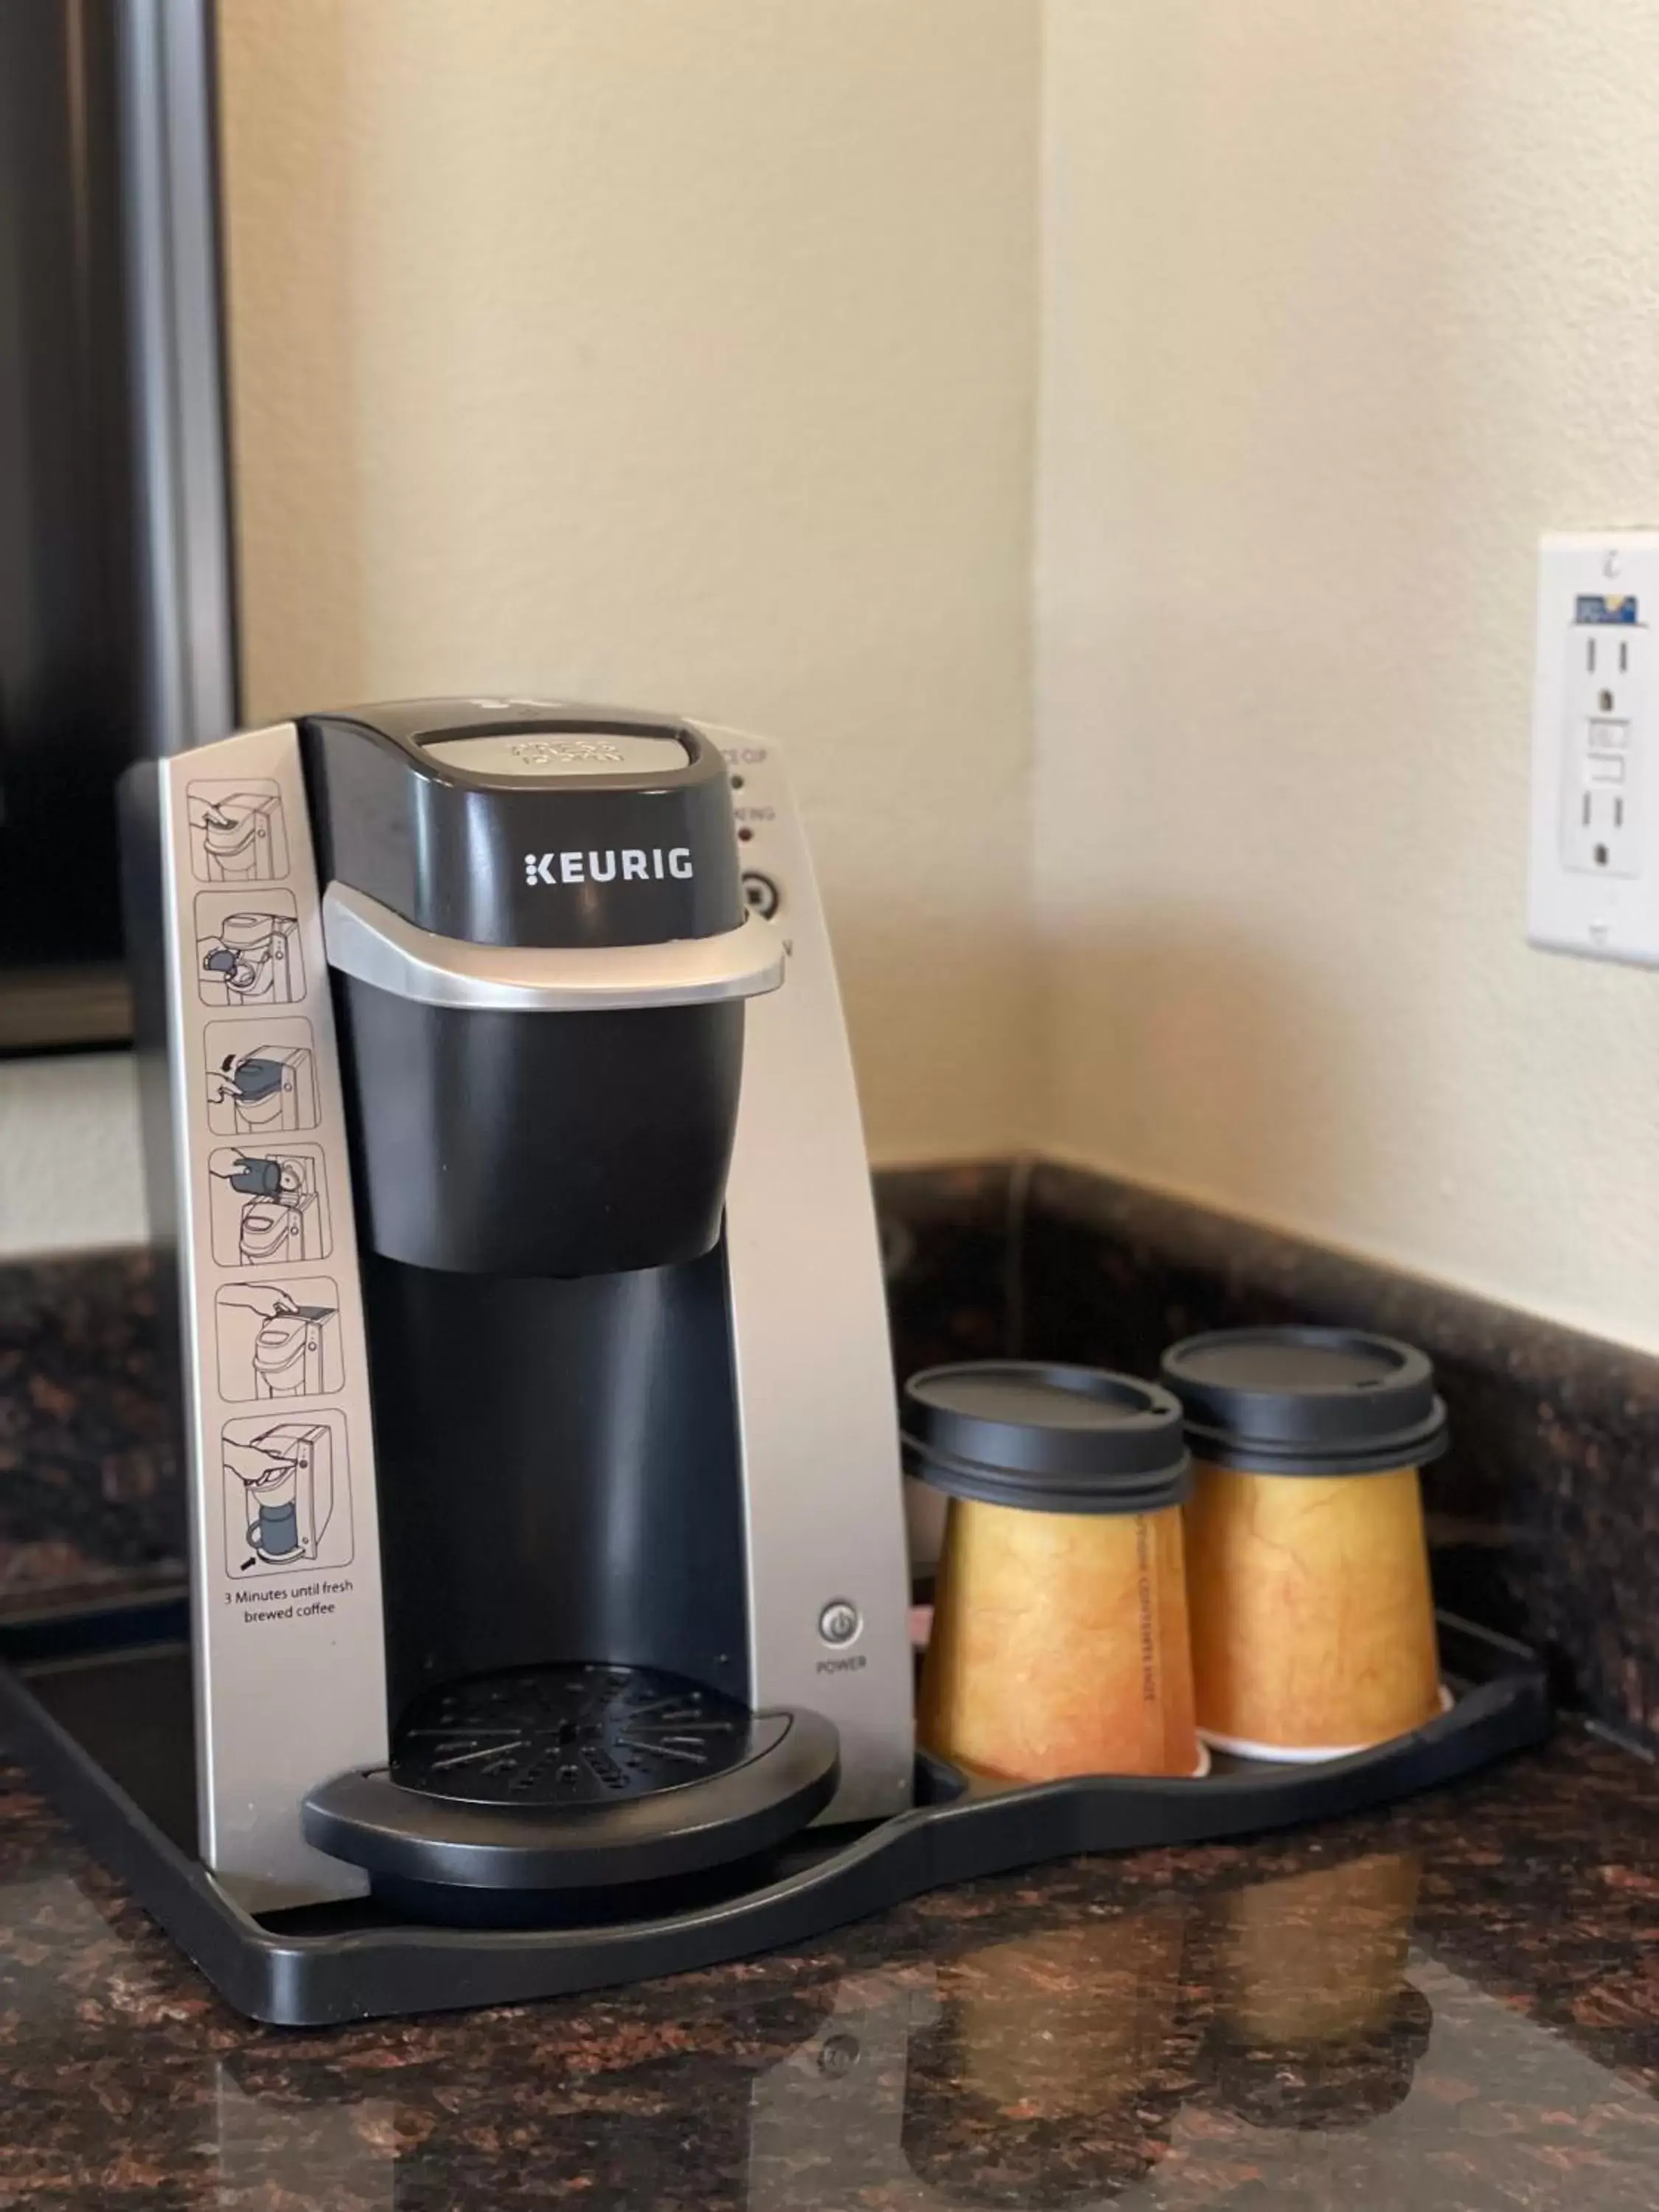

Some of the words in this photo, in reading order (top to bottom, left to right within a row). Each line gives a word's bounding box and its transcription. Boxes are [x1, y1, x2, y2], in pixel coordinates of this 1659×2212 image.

[524, 847, 694, 886] KEURIG
[224, 1592, 232, 1605] 3
[235, 1589, 288, 1604] Minutes
[291, 1583, 320, 1599] until
[322, 1579, 354, 1595] fresh
[244, 1606, 293, 1624] brewed
[296, 1601, 336, 1618] coffee
[815, 1655, 867, 1675] POWER
